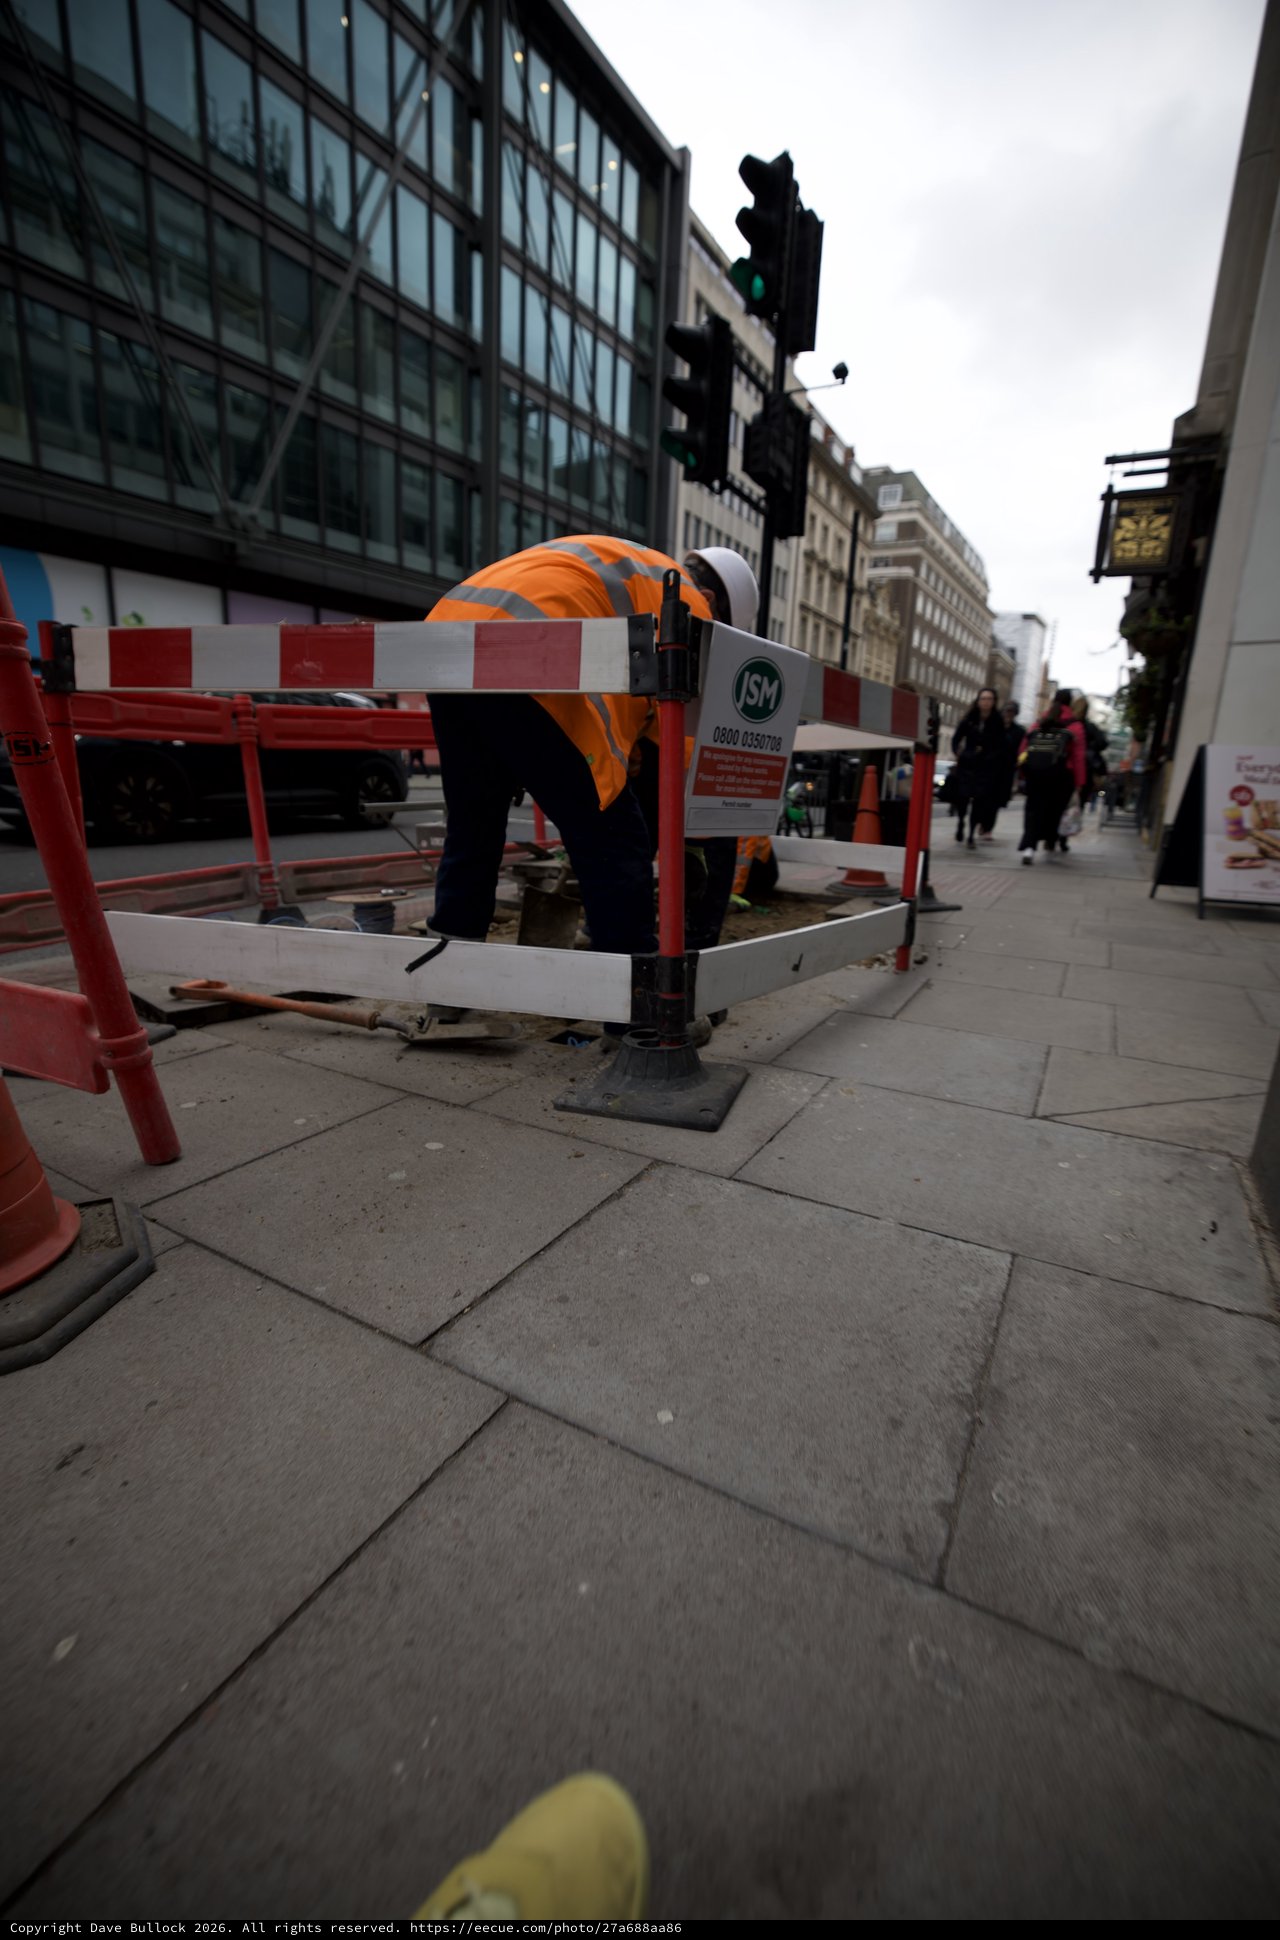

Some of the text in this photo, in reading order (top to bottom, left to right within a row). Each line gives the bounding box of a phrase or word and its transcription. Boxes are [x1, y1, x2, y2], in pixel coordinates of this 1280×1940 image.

[736, 671, 779, 710] JSM
[713, 726, 782, 752] 0800 0350708
[716, 774, 725, 782] call
